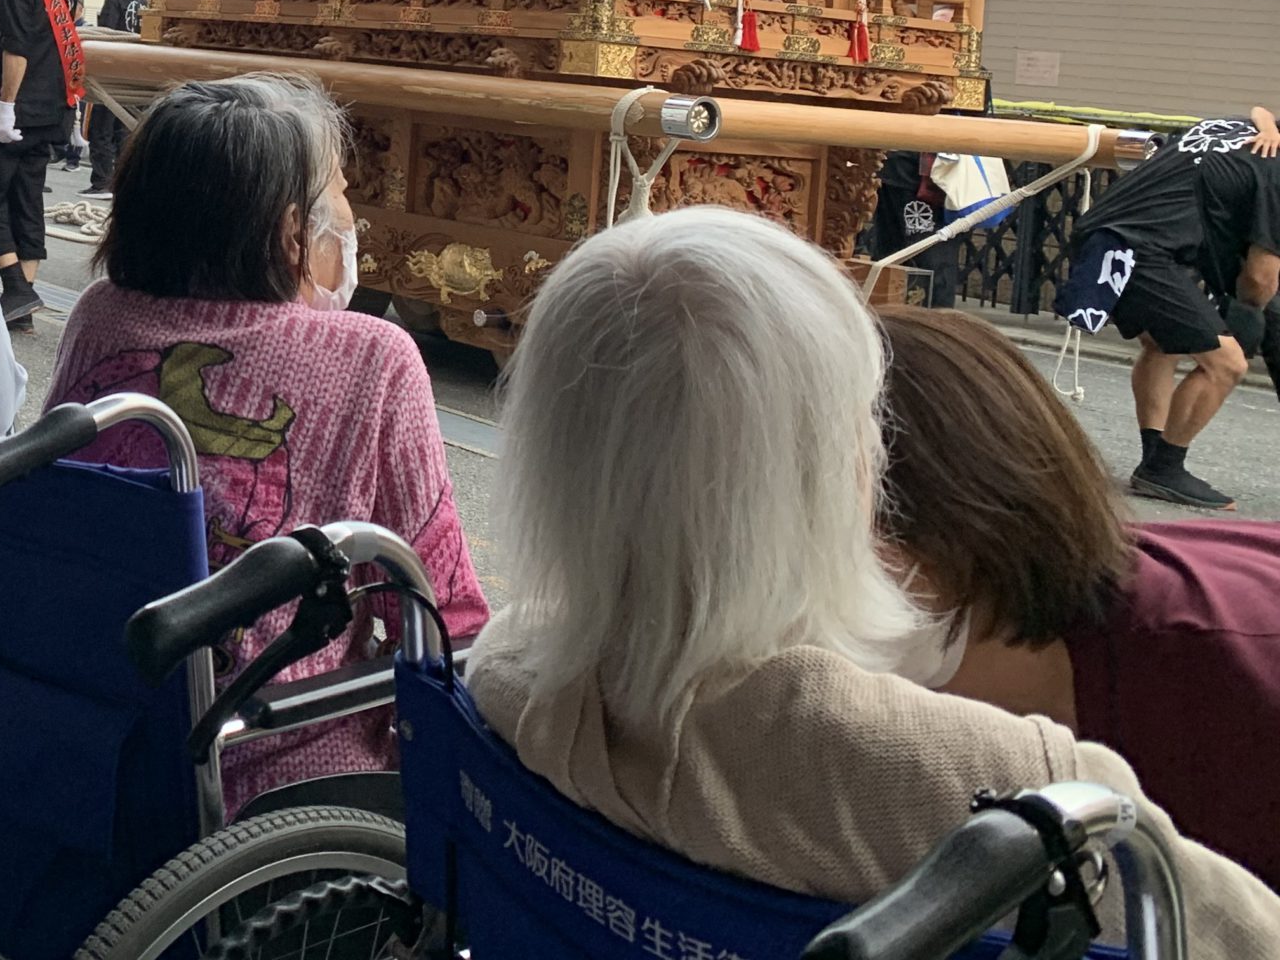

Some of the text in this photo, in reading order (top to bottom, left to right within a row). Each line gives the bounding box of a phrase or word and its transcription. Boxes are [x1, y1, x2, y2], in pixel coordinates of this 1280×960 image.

[503, 819, 750, 960] 大阪府理容生活
